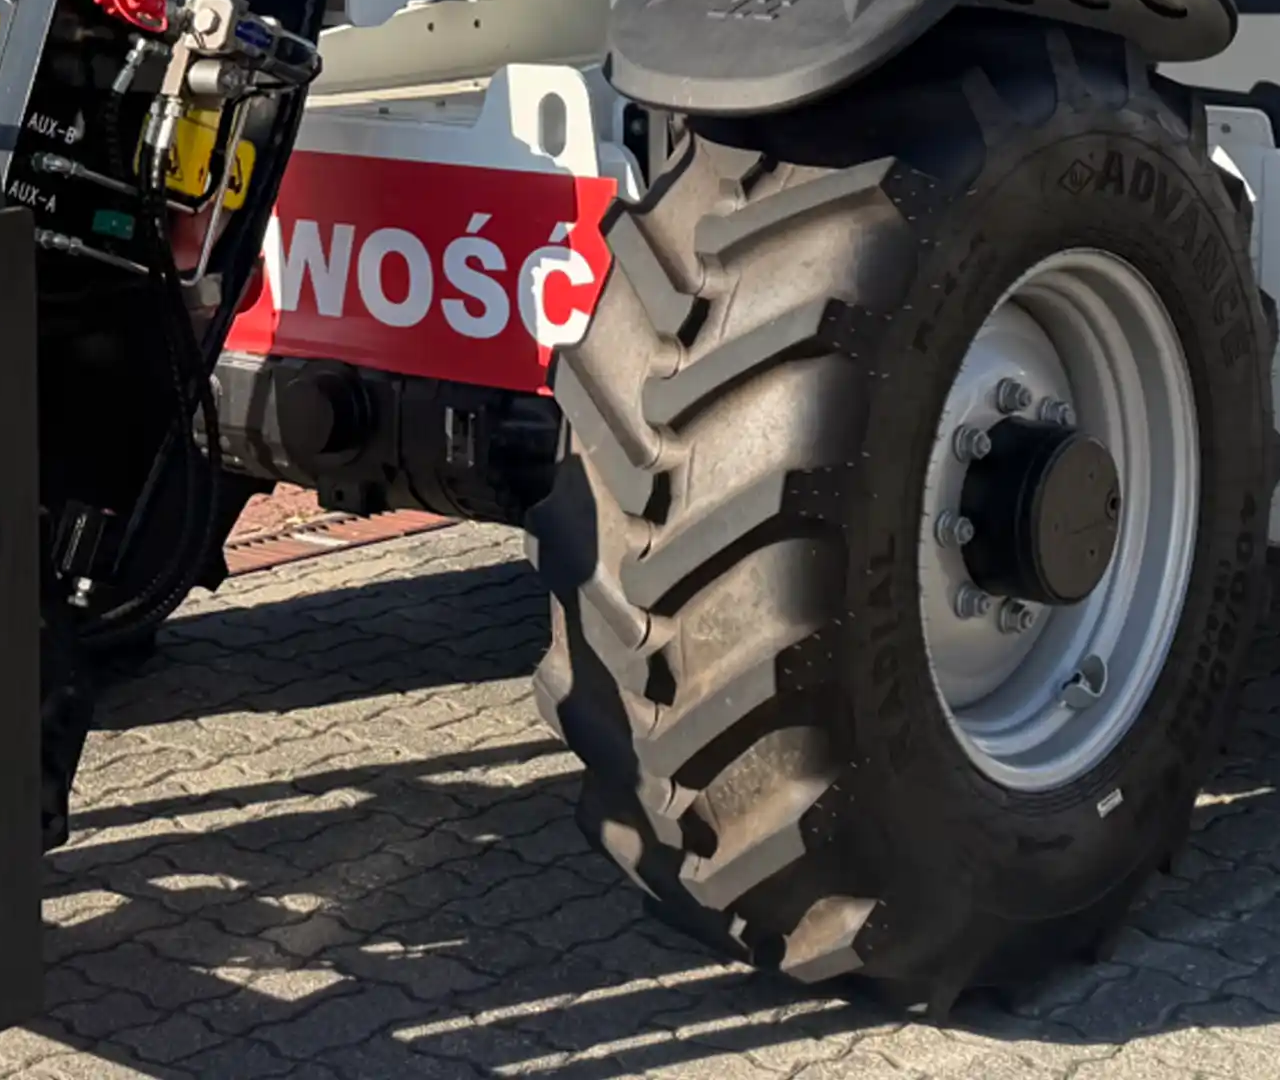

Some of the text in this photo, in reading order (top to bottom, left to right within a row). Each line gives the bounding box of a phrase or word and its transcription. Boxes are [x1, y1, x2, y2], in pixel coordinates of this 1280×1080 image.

[26, 111, 77, 145] AUX-B
[7, 179, 56, 214] AUX-A
[261, 212, 595, 348] WOŚĆ
[1092, 149, 1252, 368] ADVANCE
